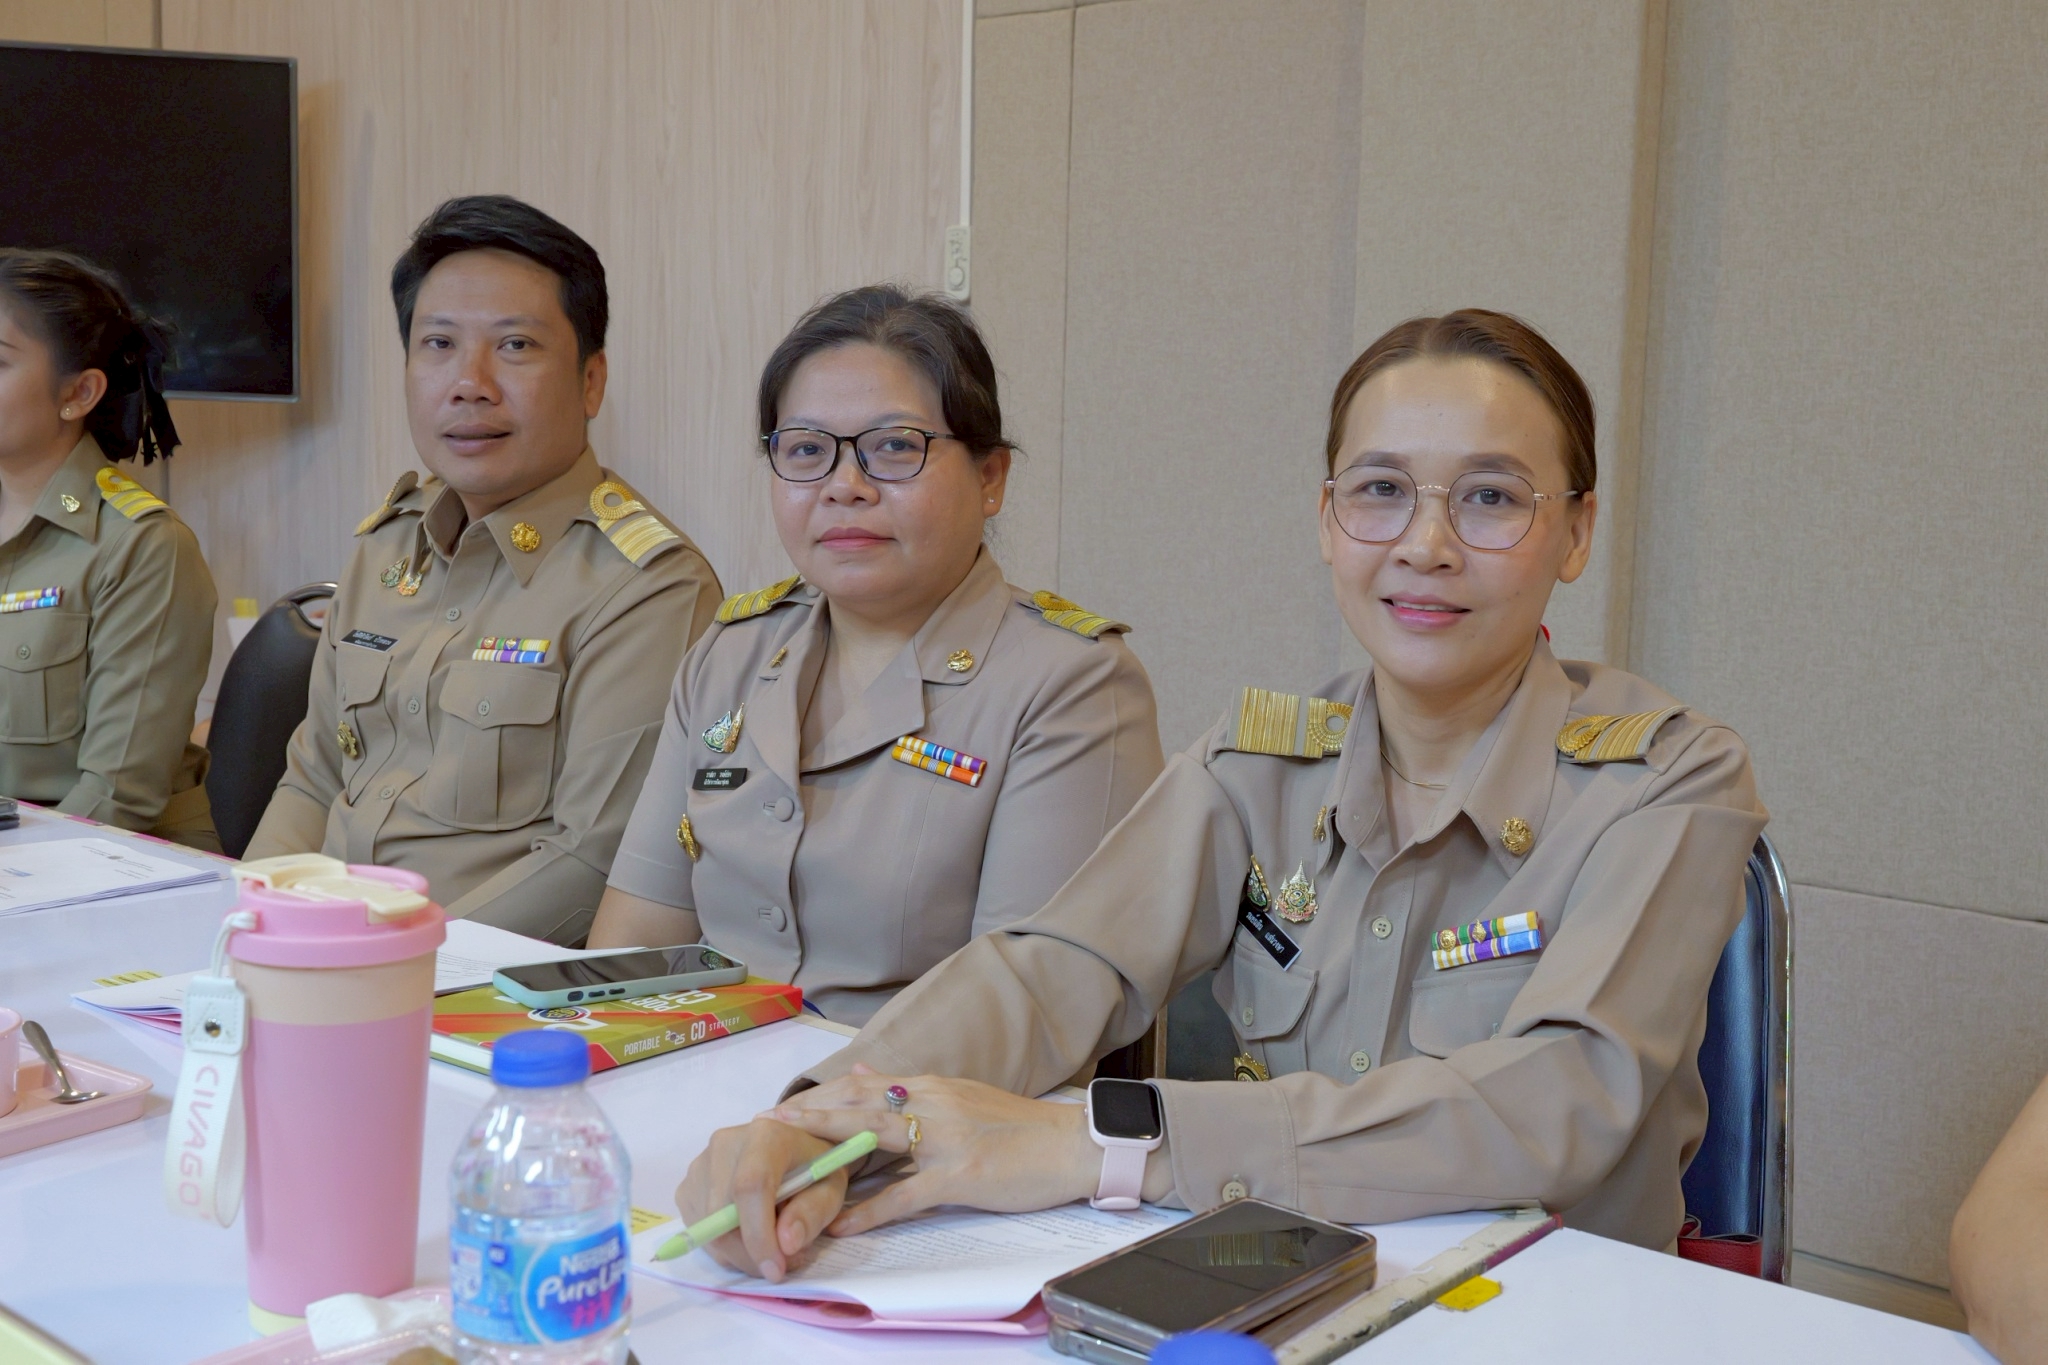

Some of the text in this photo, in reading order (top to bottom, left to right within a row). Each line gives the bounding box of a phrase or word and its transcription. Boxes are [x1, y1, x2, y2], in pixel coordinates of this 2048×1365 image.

[624, 1036, 661, 1056] PORTABLE
[691, 1020, 706, 1041] CD
[709, 1016, 740, 1031] STRATEGY
[178, 1064, 220, 1207] CIVAGO
